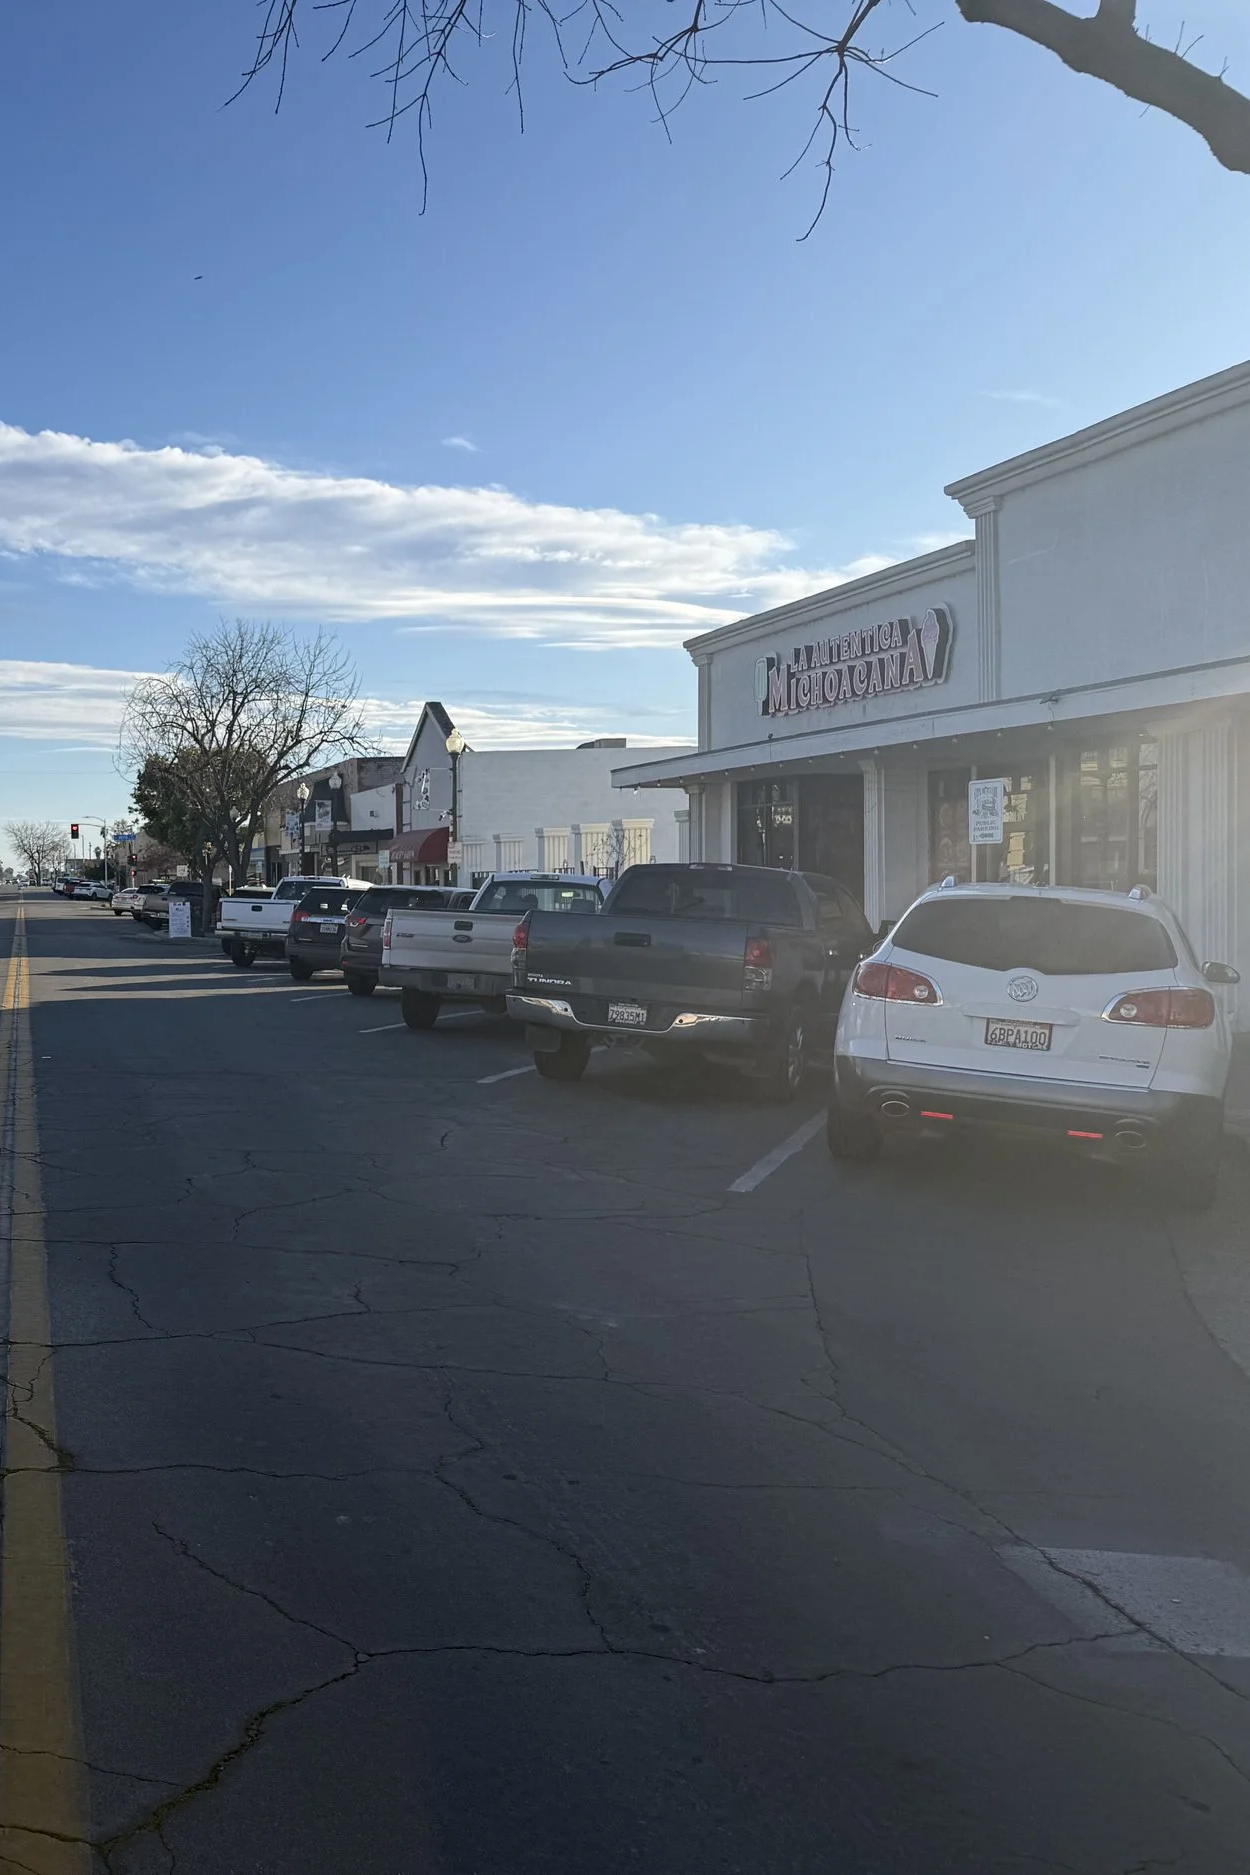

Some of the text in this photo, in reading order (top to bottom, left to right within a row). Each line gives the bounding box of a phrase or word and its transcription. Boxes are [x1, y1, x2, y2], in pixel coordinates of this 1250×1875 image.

[789, 622, 902, 673] LA AUTENTICA
[526, 977, 572, 986] TUNDRA
[989, 1026, 1048, 1048] 6BPA100
